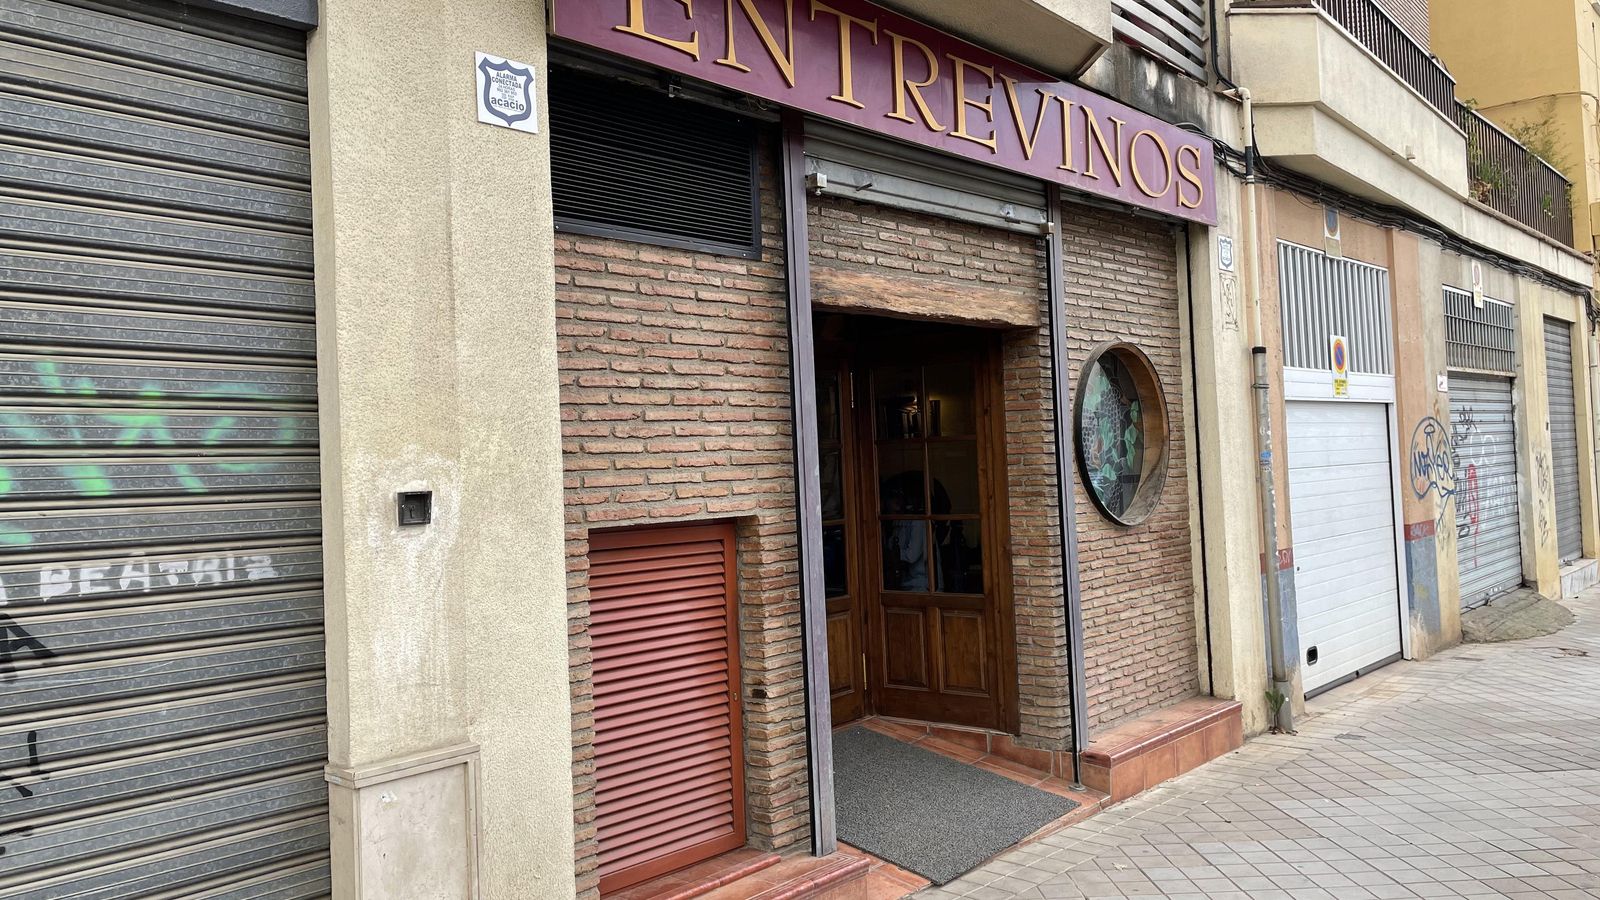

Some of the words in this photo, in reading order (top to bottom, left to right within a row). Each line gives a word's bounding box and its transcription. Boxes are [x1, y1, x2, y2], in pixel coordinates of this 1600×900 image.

[491, 76, 522, 89] CONECTADA
[496, 72, 517, 81] ALARMA
[491, 96, 525, 111] acacio
[611, 0, 1204, 209] ENTREVINOS
